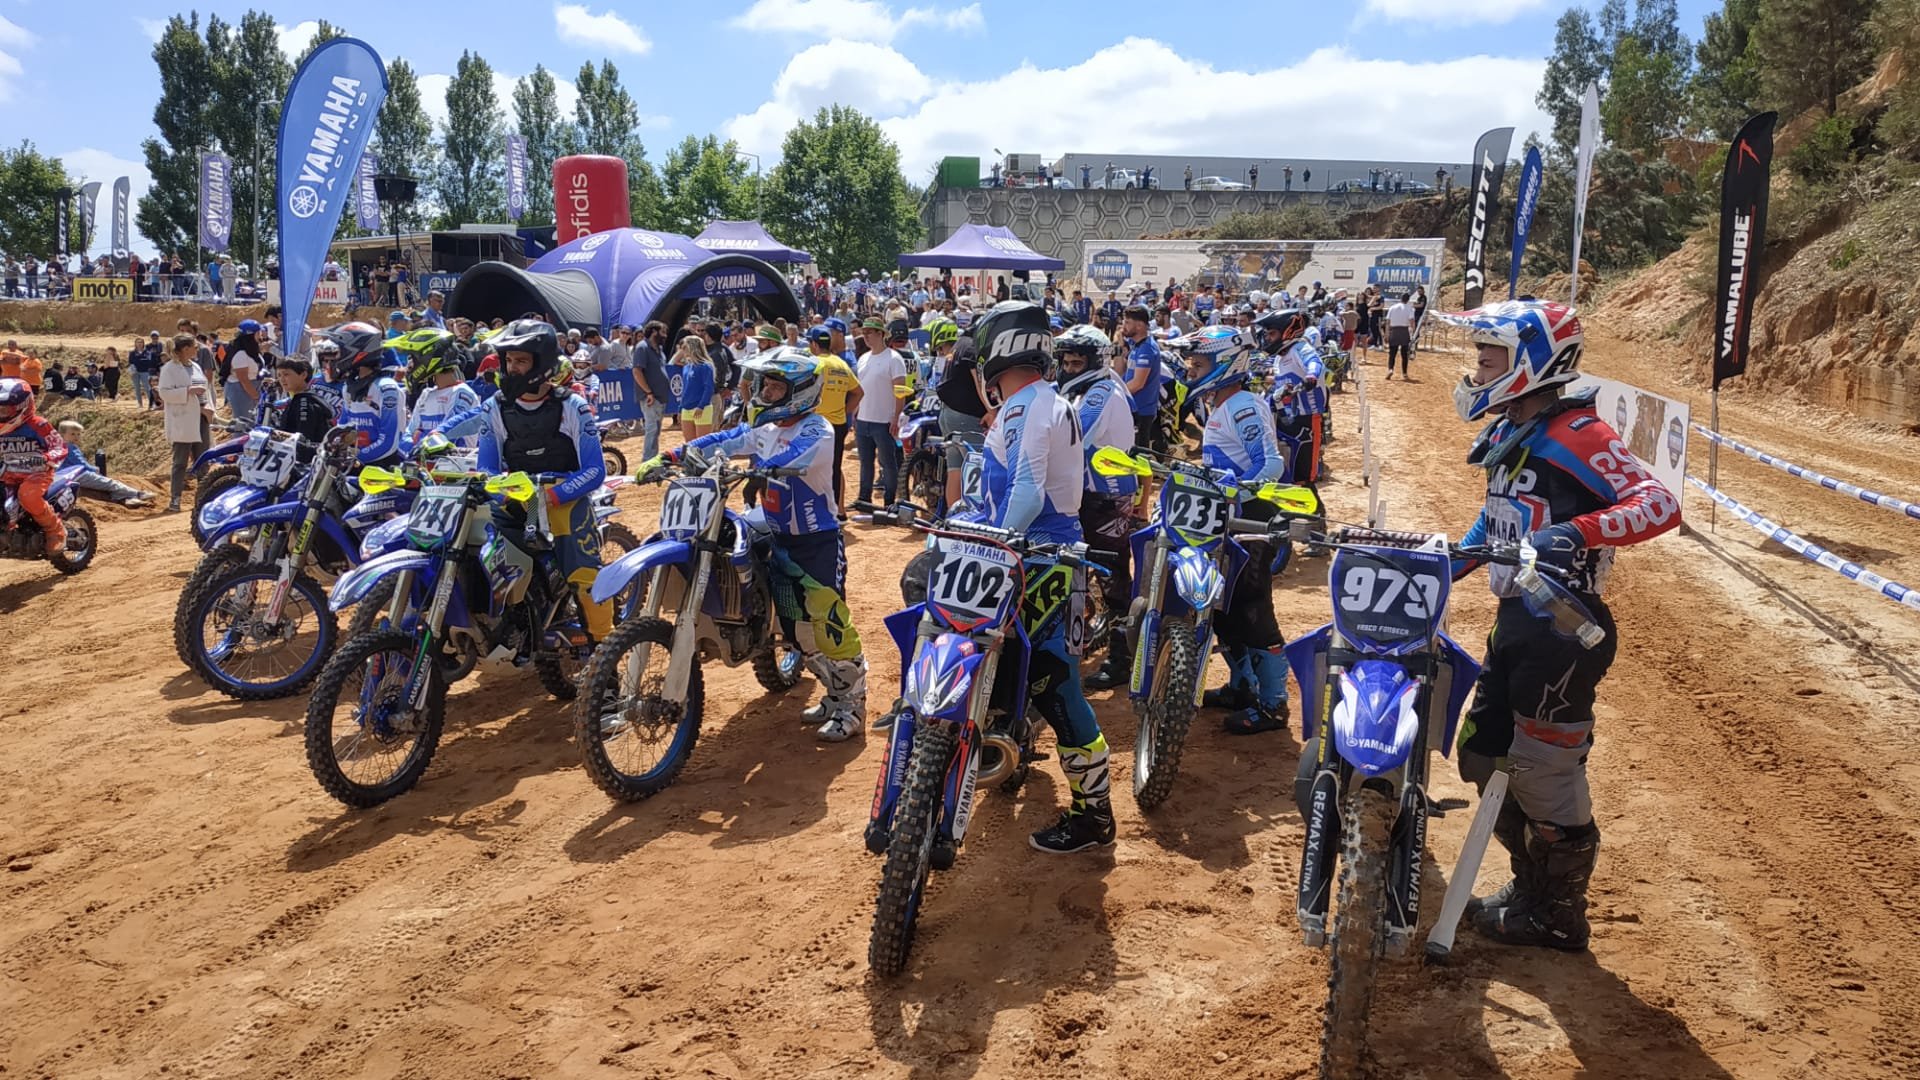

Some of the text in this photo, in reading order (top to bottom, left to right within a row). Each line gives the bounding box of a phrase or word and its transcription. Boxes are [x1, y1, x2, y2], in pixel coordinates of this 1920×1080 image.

[298, 75, 361, 184] YAMAHA
[208, 160, 224, 220] YAMAHA
[1468, 149, 1496, 266] SCOTT
[716, 273, 757, 290] YAMAHA
[1094, 265, 1126, 278] YAMAHA
[1376, 268, 1423, 283] YAMAHA
[1721, 214, 1750, 359] YAMALUBE
[667, 492, 704, 528] 111
[803, 499, 822, 533] YAMA
[1170, 494, 1228, 535] 235
[1486, 515, 1518, 542] MAHA
[963, 543, 1006, 562] YAMAHA
[941, 556, 1005, 608] 102
[1340, 566, 1441, 619] 979
[891, 749, 910, 787] YAMAHA
[1357, 738, 1399, 757] YAMAHA
[957, 768, 978, 816] YAMAHA
[1301, 790, 1327, 893] RE/MAX LATINA
[1408, 807, 1426, 912] RE/MAX LATINA
